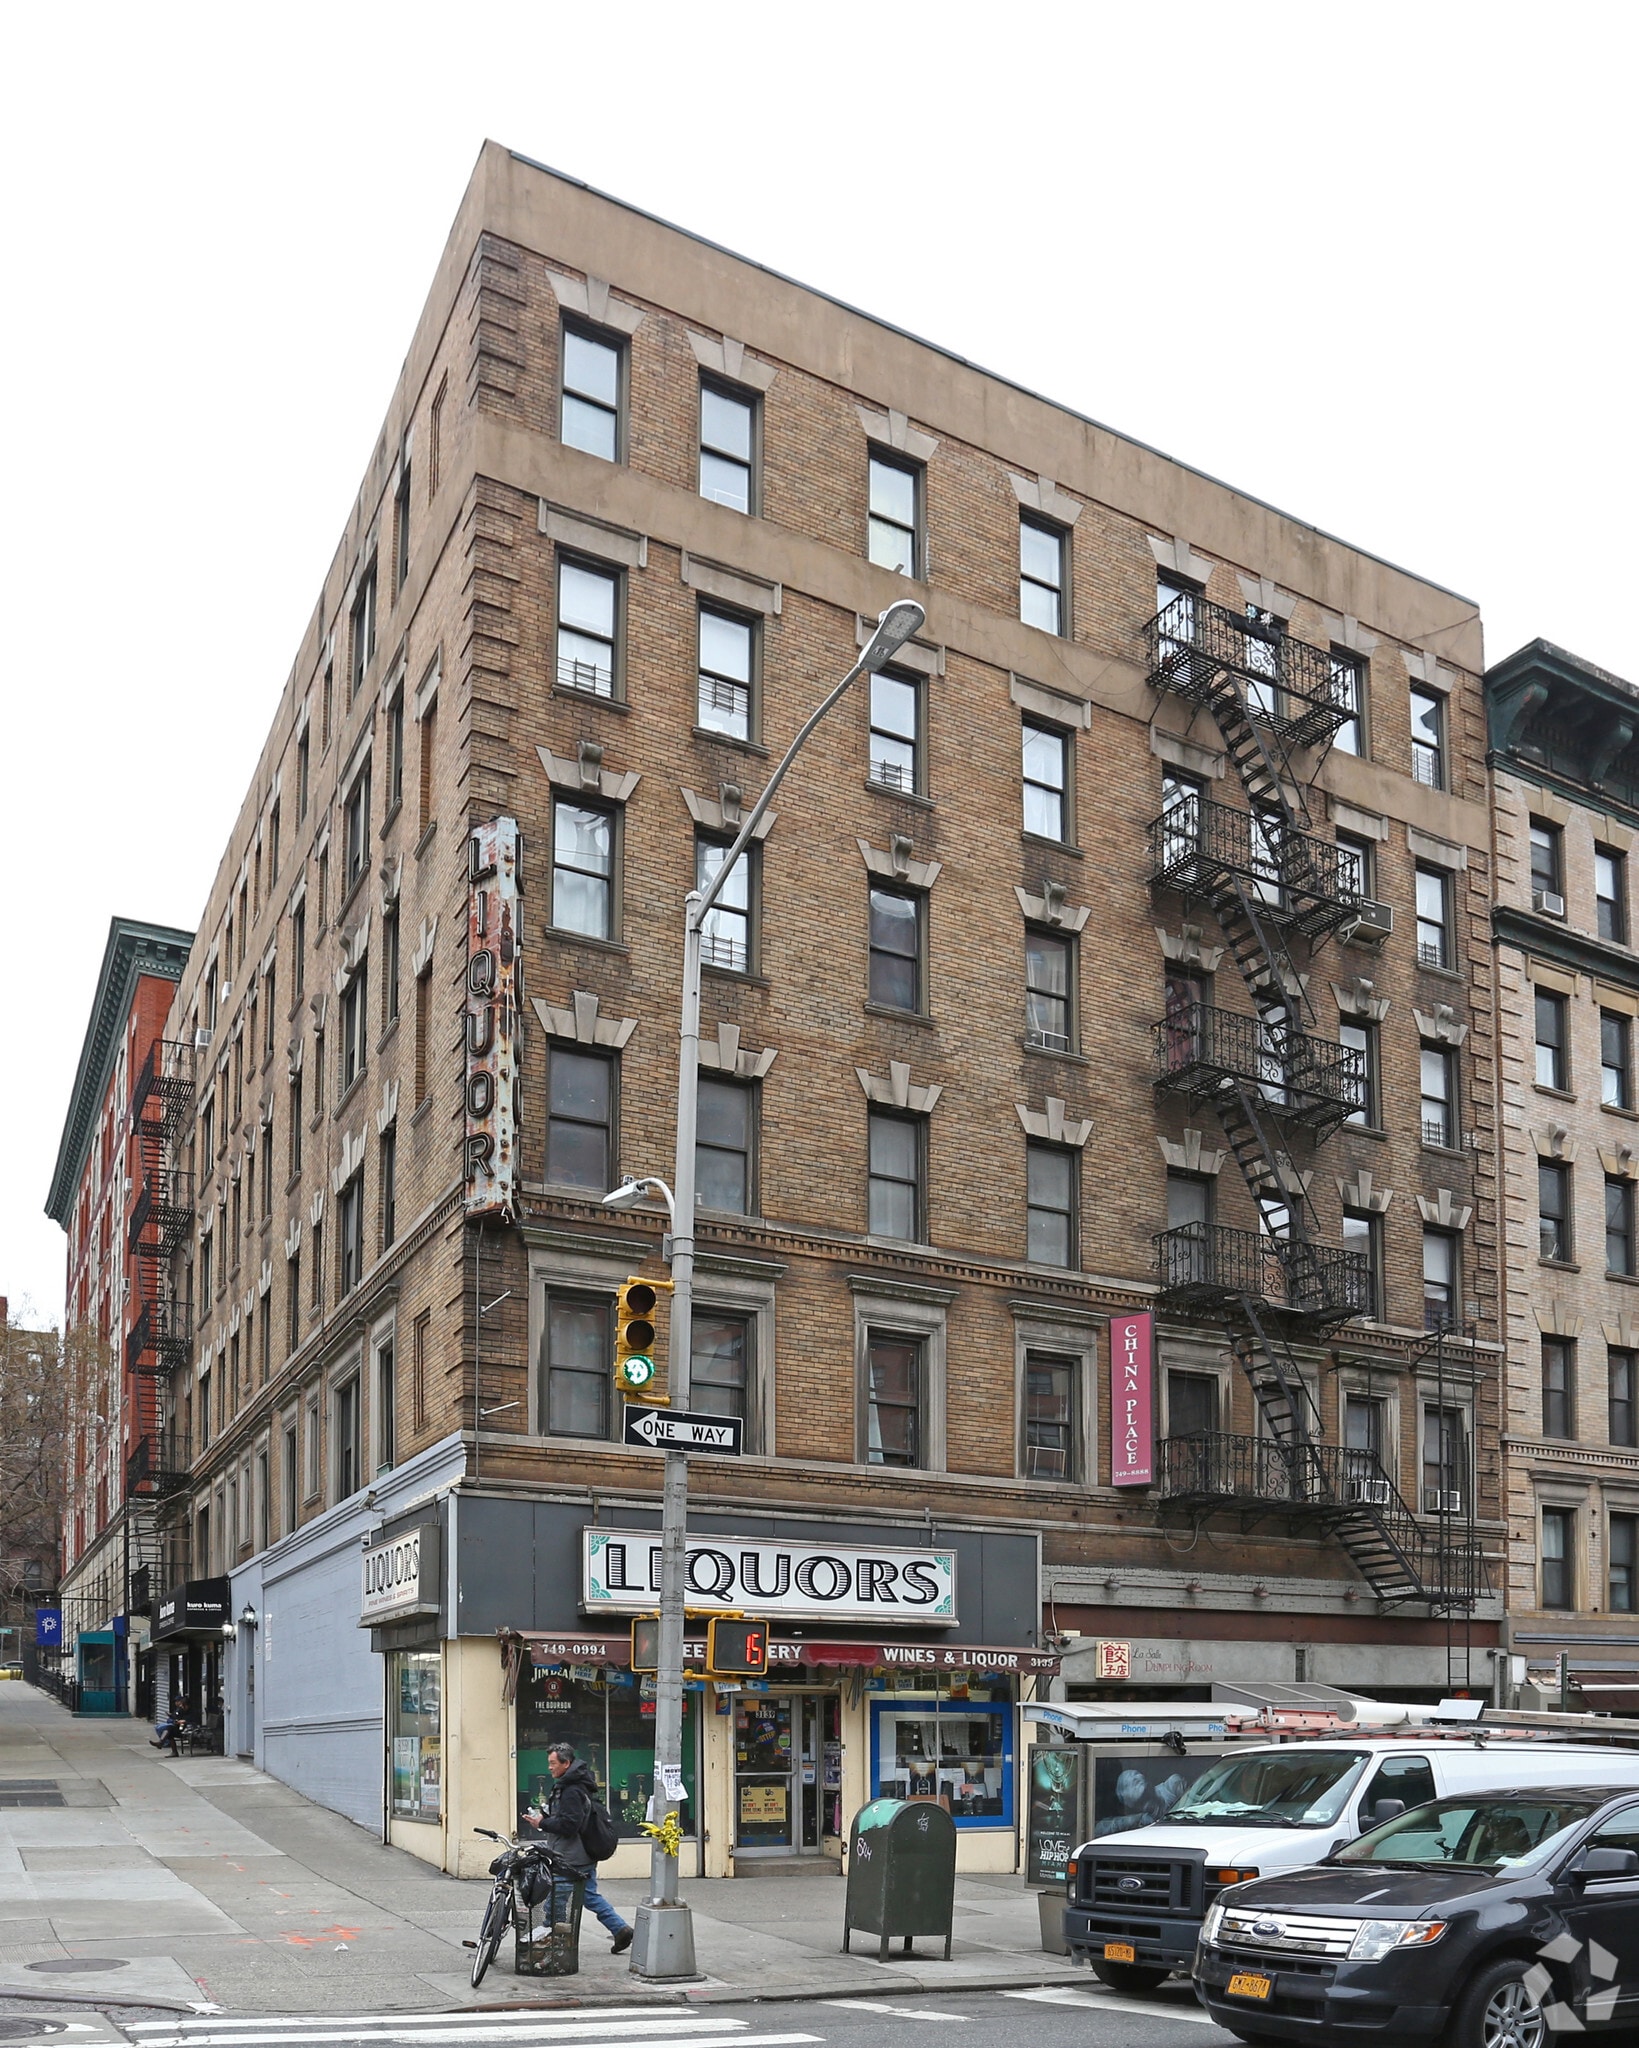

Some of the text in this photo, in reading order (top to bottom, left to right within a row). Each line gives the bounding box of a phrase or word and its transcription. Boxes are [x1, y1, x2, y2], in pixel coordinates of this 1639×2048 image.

[465, 837, 497, 1182] LIQUOR
[1124, 1325, 1139, 1465] CHINA PLACE
[643, 1420, 726, 1443] ONE WAY
[365, 1539, 420, 1595] LIQUORS
[606, 1543, 941, 1604] LIQUORS
[542, 1644, 705, 1658] 749-0994 EE
[883, 1648, 936, 1663] WINES
[943, 1651, 956, 1664] &
[962, 1652, 1018, 1667] LIQUOR
[531, 1667, 549, 1683] JIM
[545, 1701, 571, 1709] BOURBON
[755, 1710, 775, 1718] 3139
[1043, 1711, 1063, 1722] Phone
[1121, 1723, 1222, 1732] Phone Pho
[1039, 1839, 1065, 1852] LOVE
[1042, 1860, 1066, 1868] MIAMI
